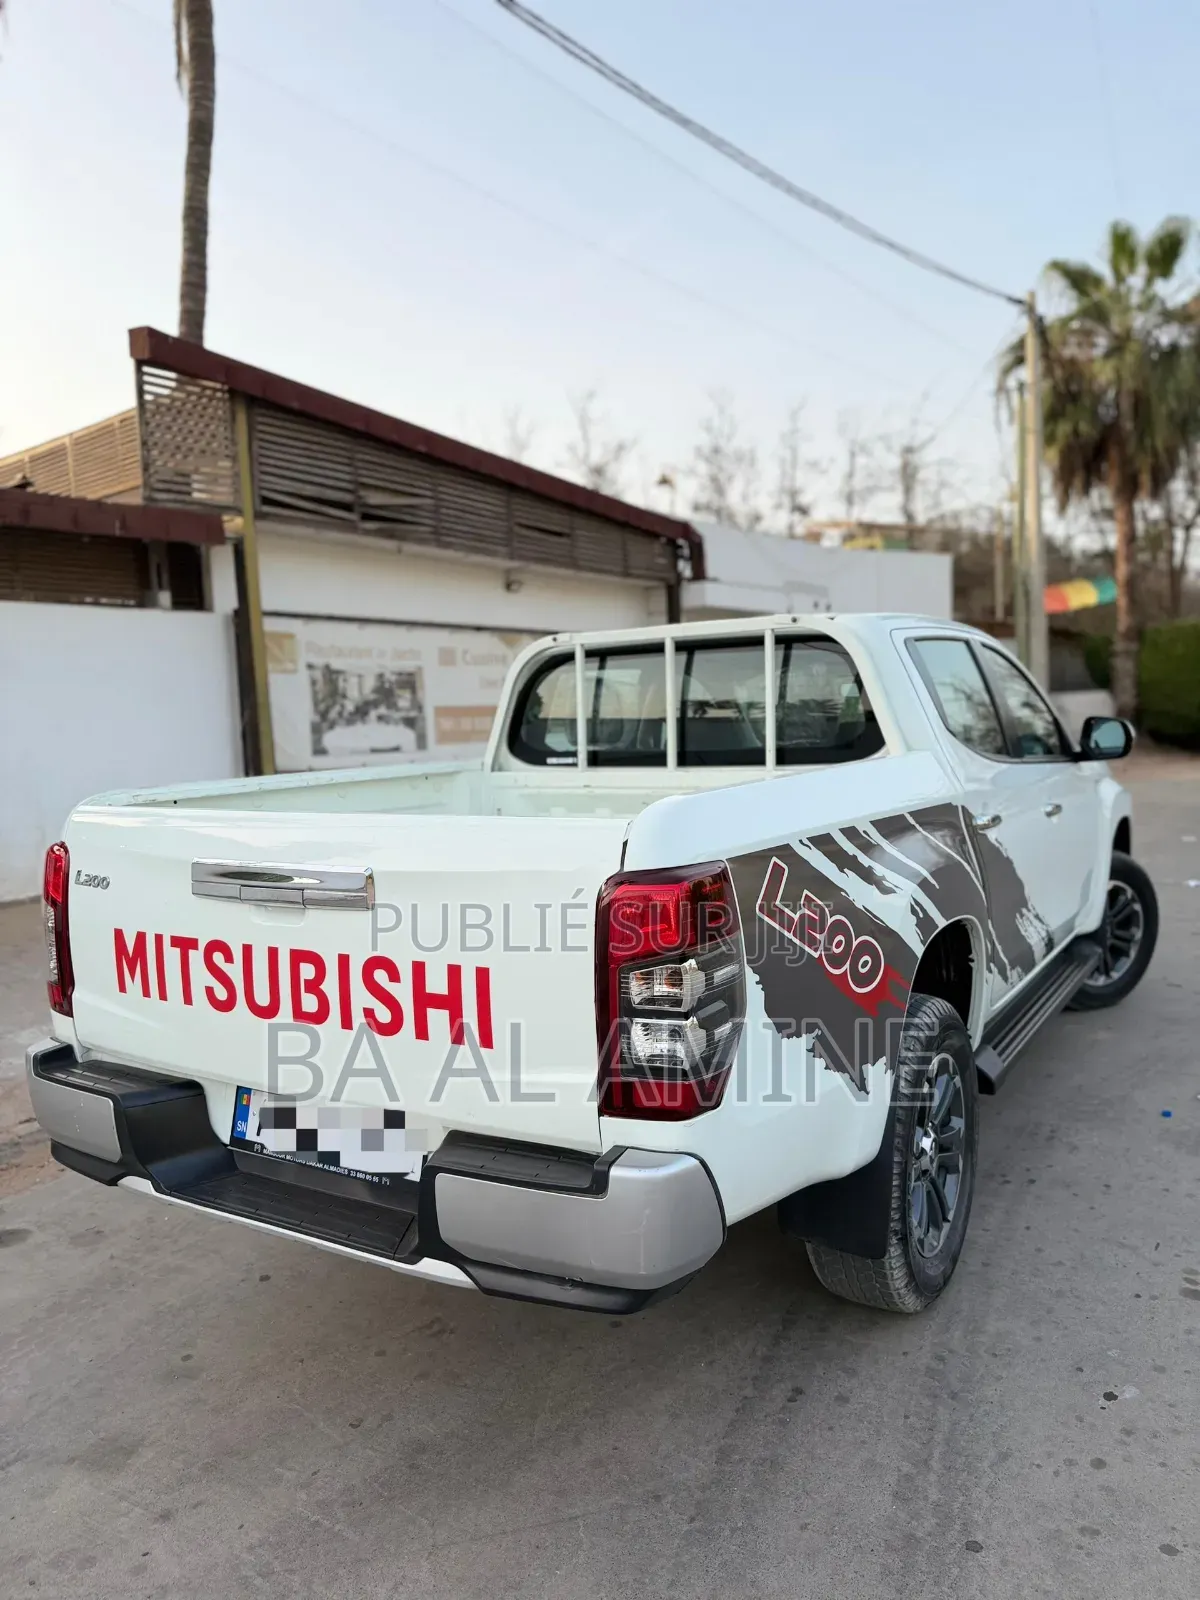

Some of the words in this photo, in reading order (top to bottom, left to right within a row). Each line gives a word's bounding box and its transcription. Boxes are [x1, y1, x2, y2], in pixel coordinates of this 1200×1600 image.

[75, 869, 110, 890] L200
[756, 856, 885, 993] L200
[113, 927, 494, 1049] MITSUBISHI
[236, 1120, 247, 1133] SN
